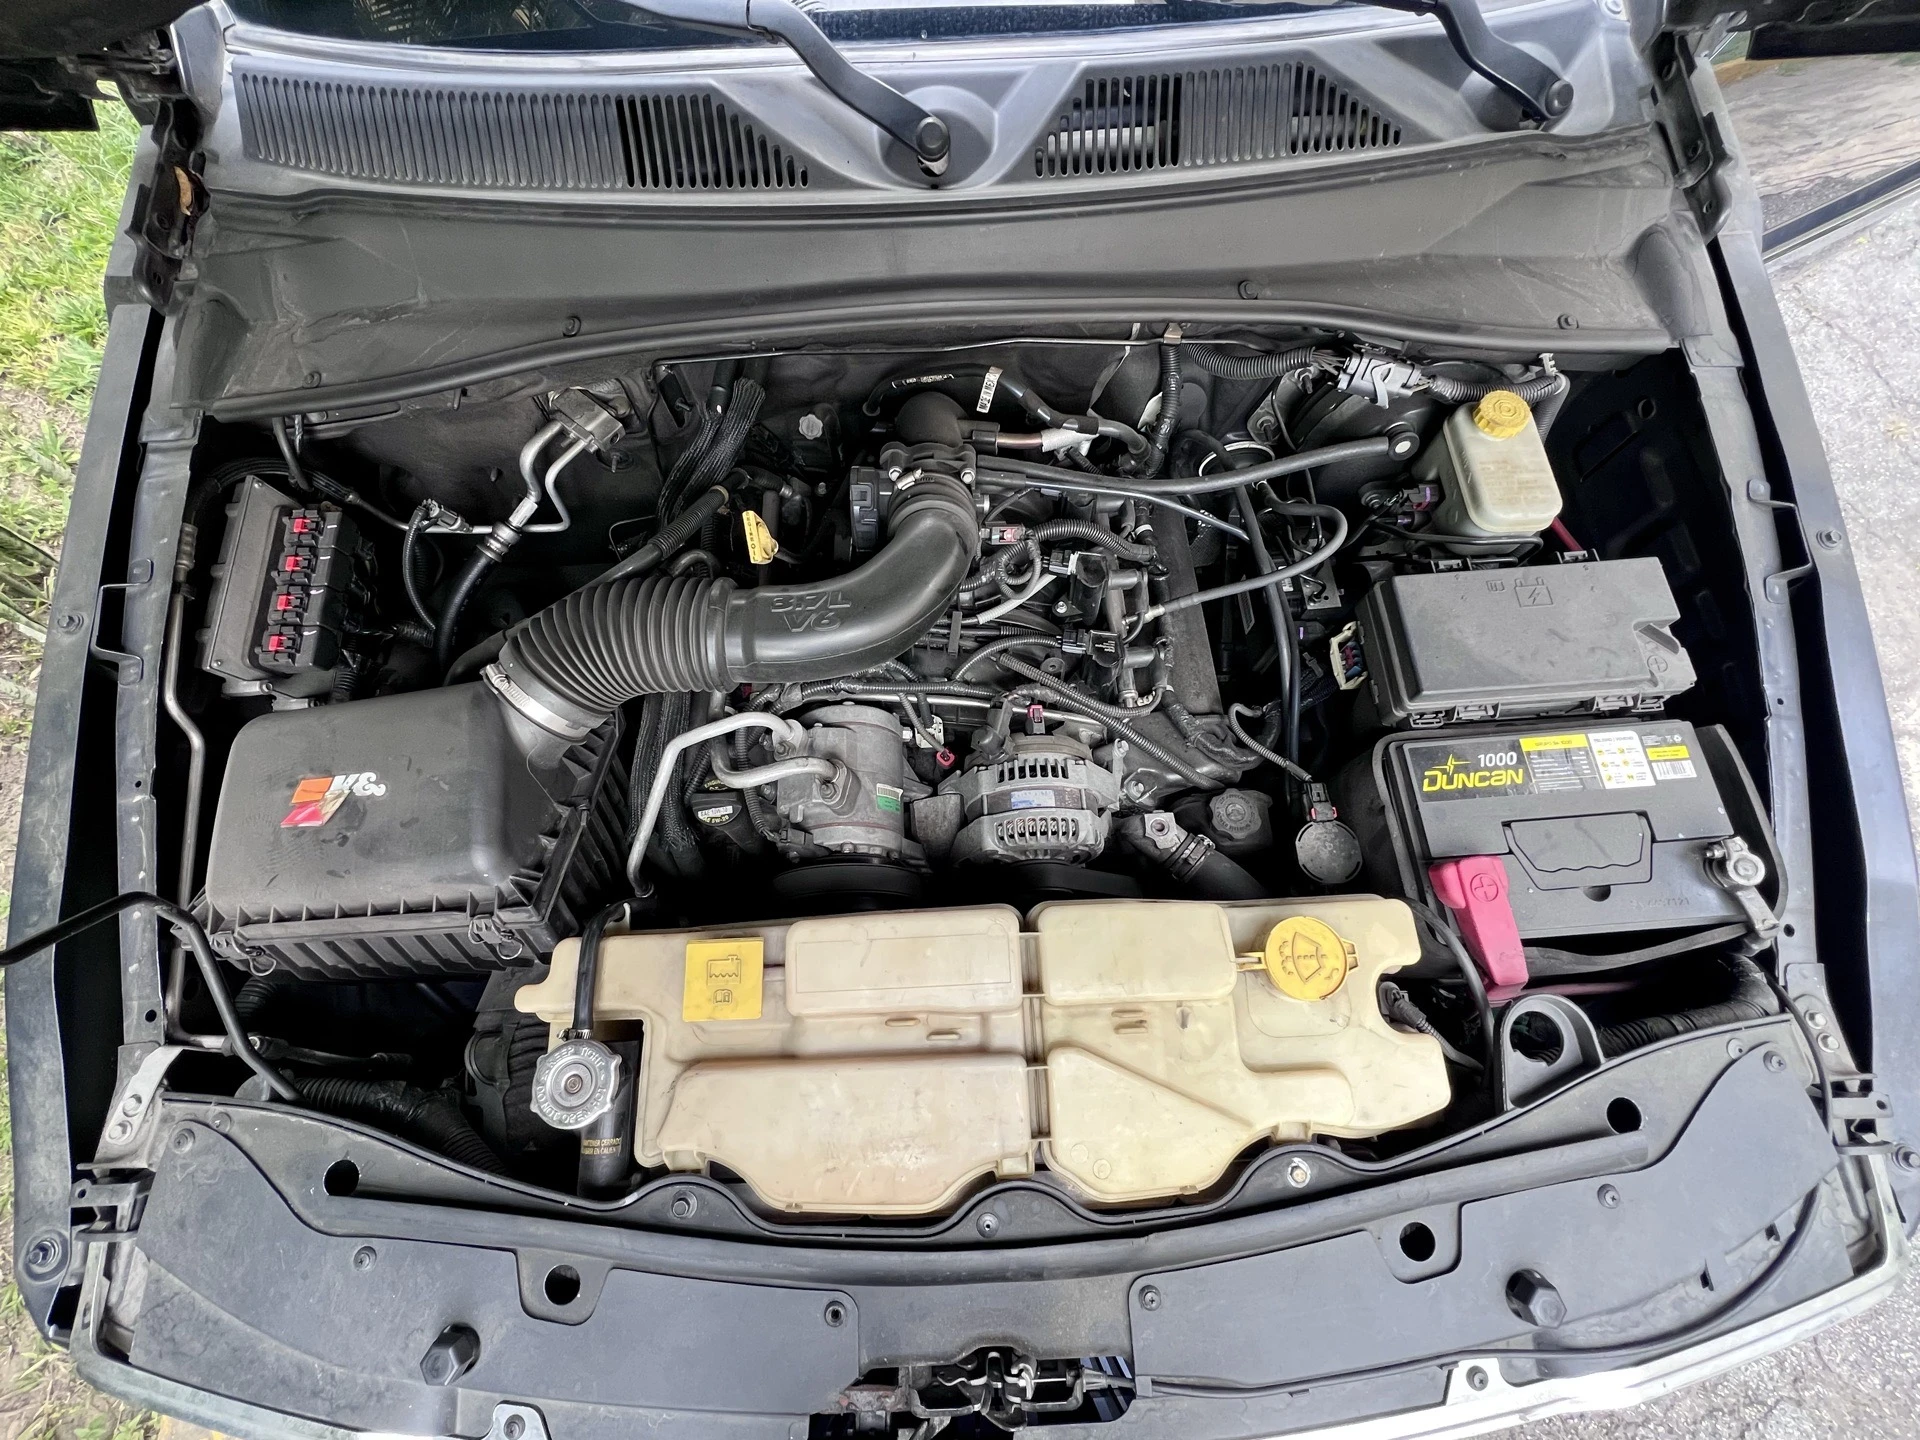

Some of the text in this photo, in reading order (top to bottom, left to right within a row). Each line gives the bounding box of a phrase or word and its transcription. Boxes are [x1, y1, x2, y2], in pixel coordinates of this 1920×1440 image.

[771, 591, 851, 612] 3.7L
[783, 611, 841, 632] V6
[1477, 751, 1518, 767] 1000
[1422, 768, 1523, 792] DUNCAN
[546, 1045, 605, 1069] KEEP TIGHT
[536, 1085, 546, 1102] DO
[540, 1101, 561, 1121] NOT
[562, 1109, 592, 1124] OPEN
